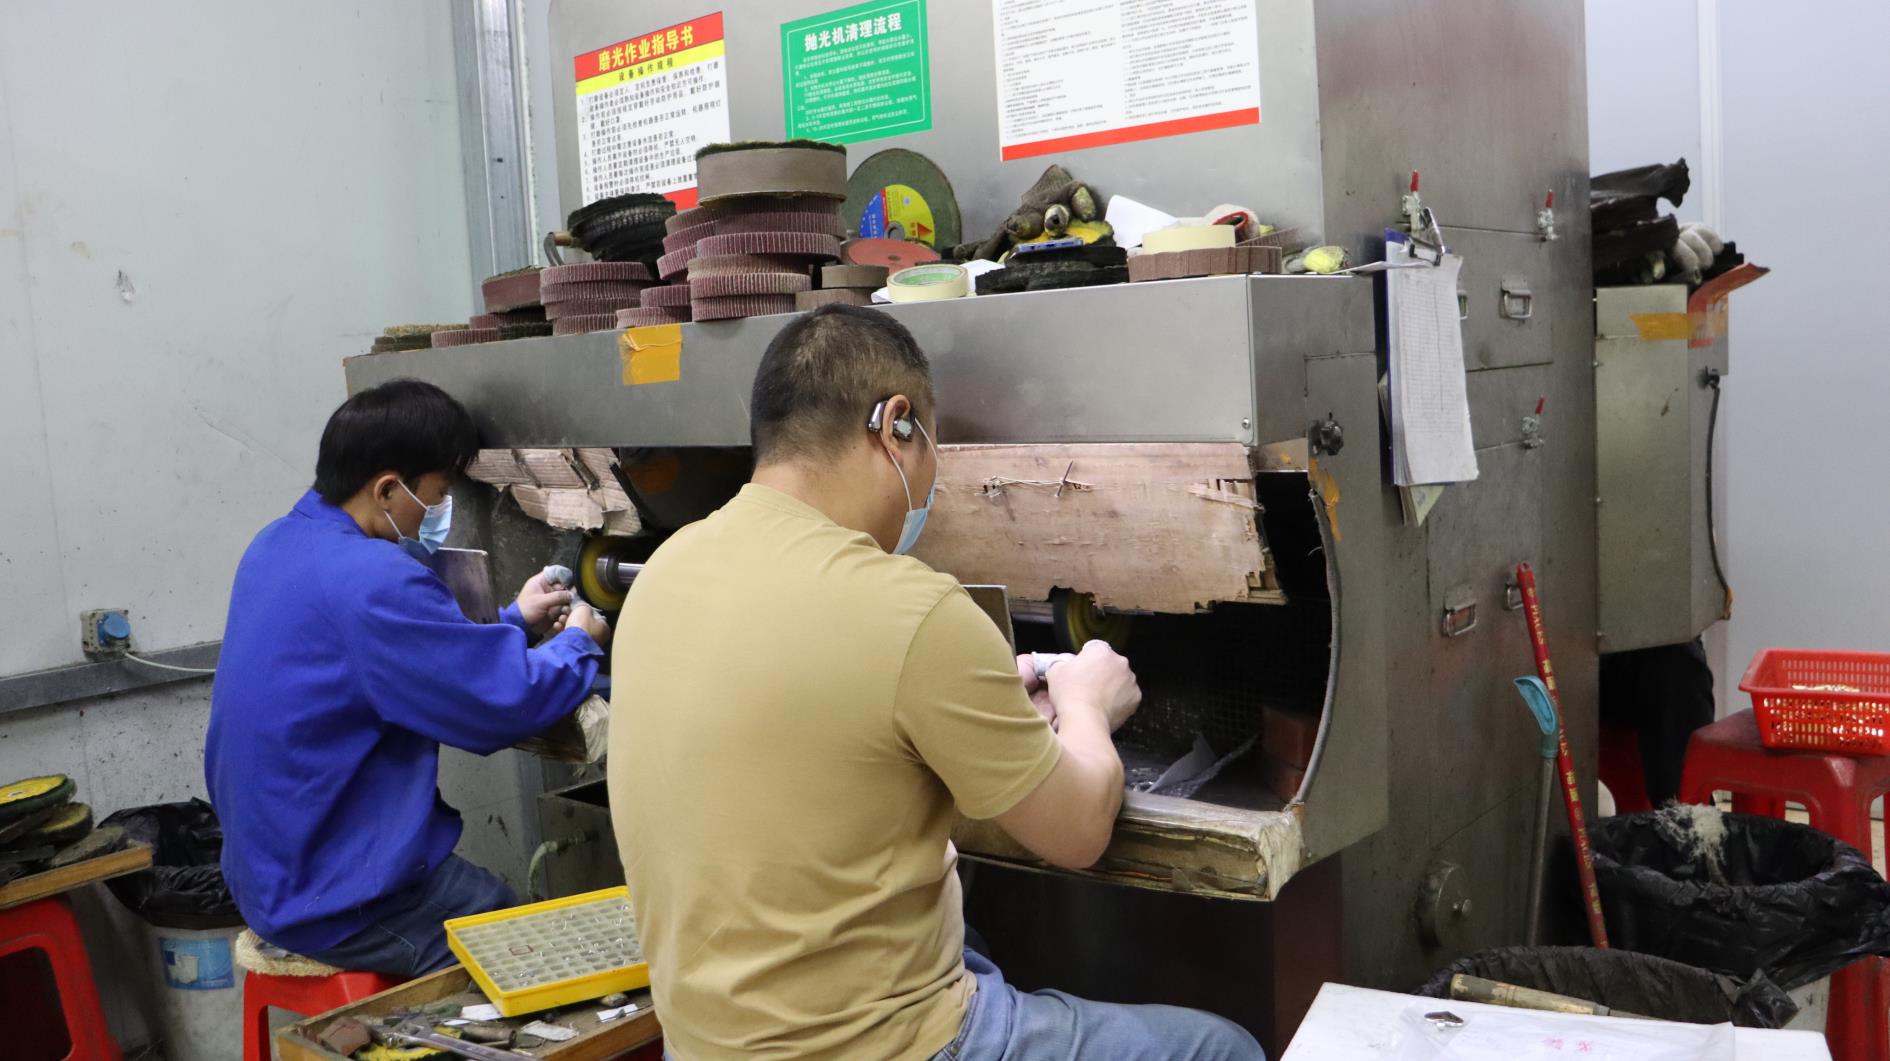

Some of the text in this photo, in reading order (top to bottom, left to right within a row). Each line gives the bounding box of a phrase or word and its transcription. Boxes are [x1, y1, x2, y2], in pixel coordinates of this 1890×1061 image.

[598, 25, 694, 71] 磨光作业指导书
[804, 12, 902, 52] 抛光机清理流程
